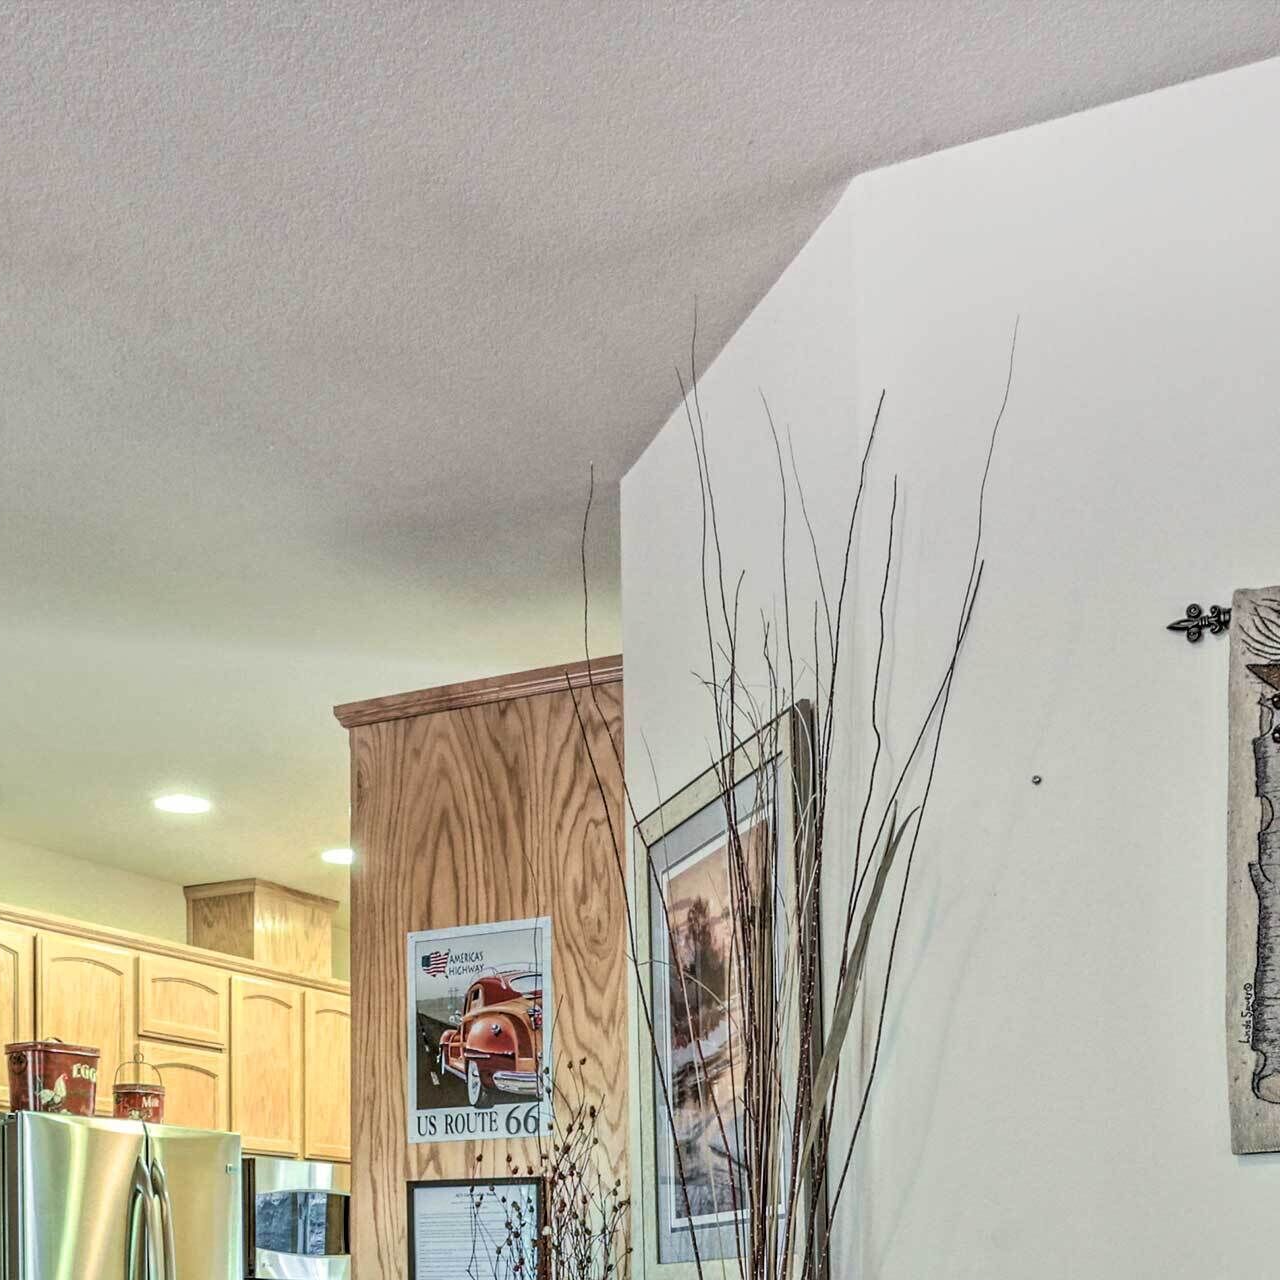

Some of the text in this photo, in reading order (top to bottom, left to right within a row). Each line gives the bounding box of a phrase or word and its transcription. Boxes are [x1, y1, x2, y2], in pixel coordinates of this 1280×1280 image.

[449, 964, 484, 975] HIGHWAY
[417, 1104, 540, 1137] US ROUTE 66
